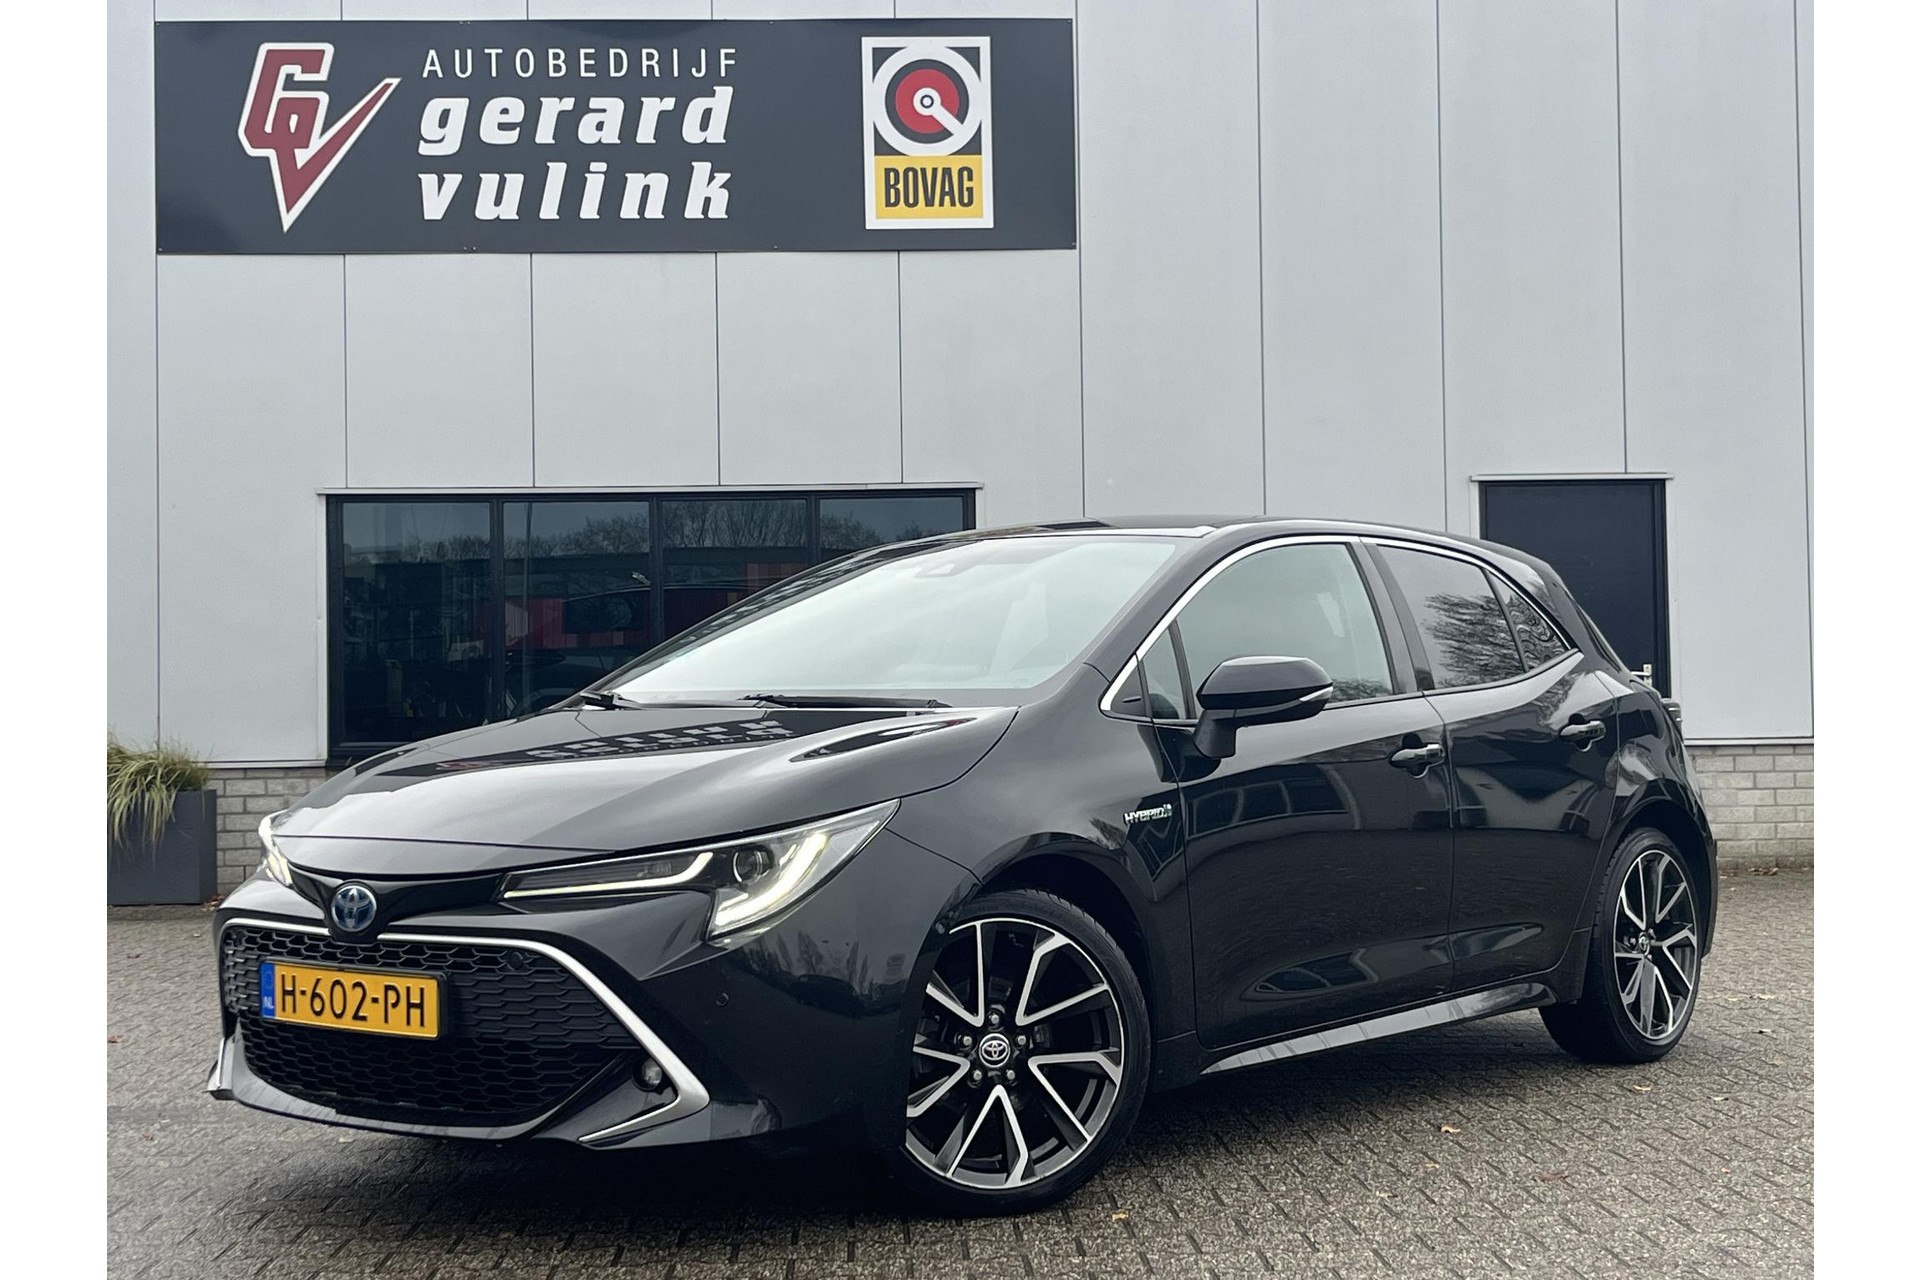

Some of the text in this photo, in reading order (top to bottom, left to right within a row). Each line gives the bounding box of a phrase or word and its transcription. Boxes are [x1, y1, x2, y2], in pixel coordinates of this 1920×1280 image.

[422, 48, 738, 78] AUTOBEDRIJF
[418, 86, 734, 156] gerard
[418, 161, 732, 220] vulink
[884, 166, 974, 208] BOVAG
[1124, 807, 1165, 823] HYBRID
[263, 996, 274, 1009] NL
[281, 972, 425, 1027] H-602-PH
